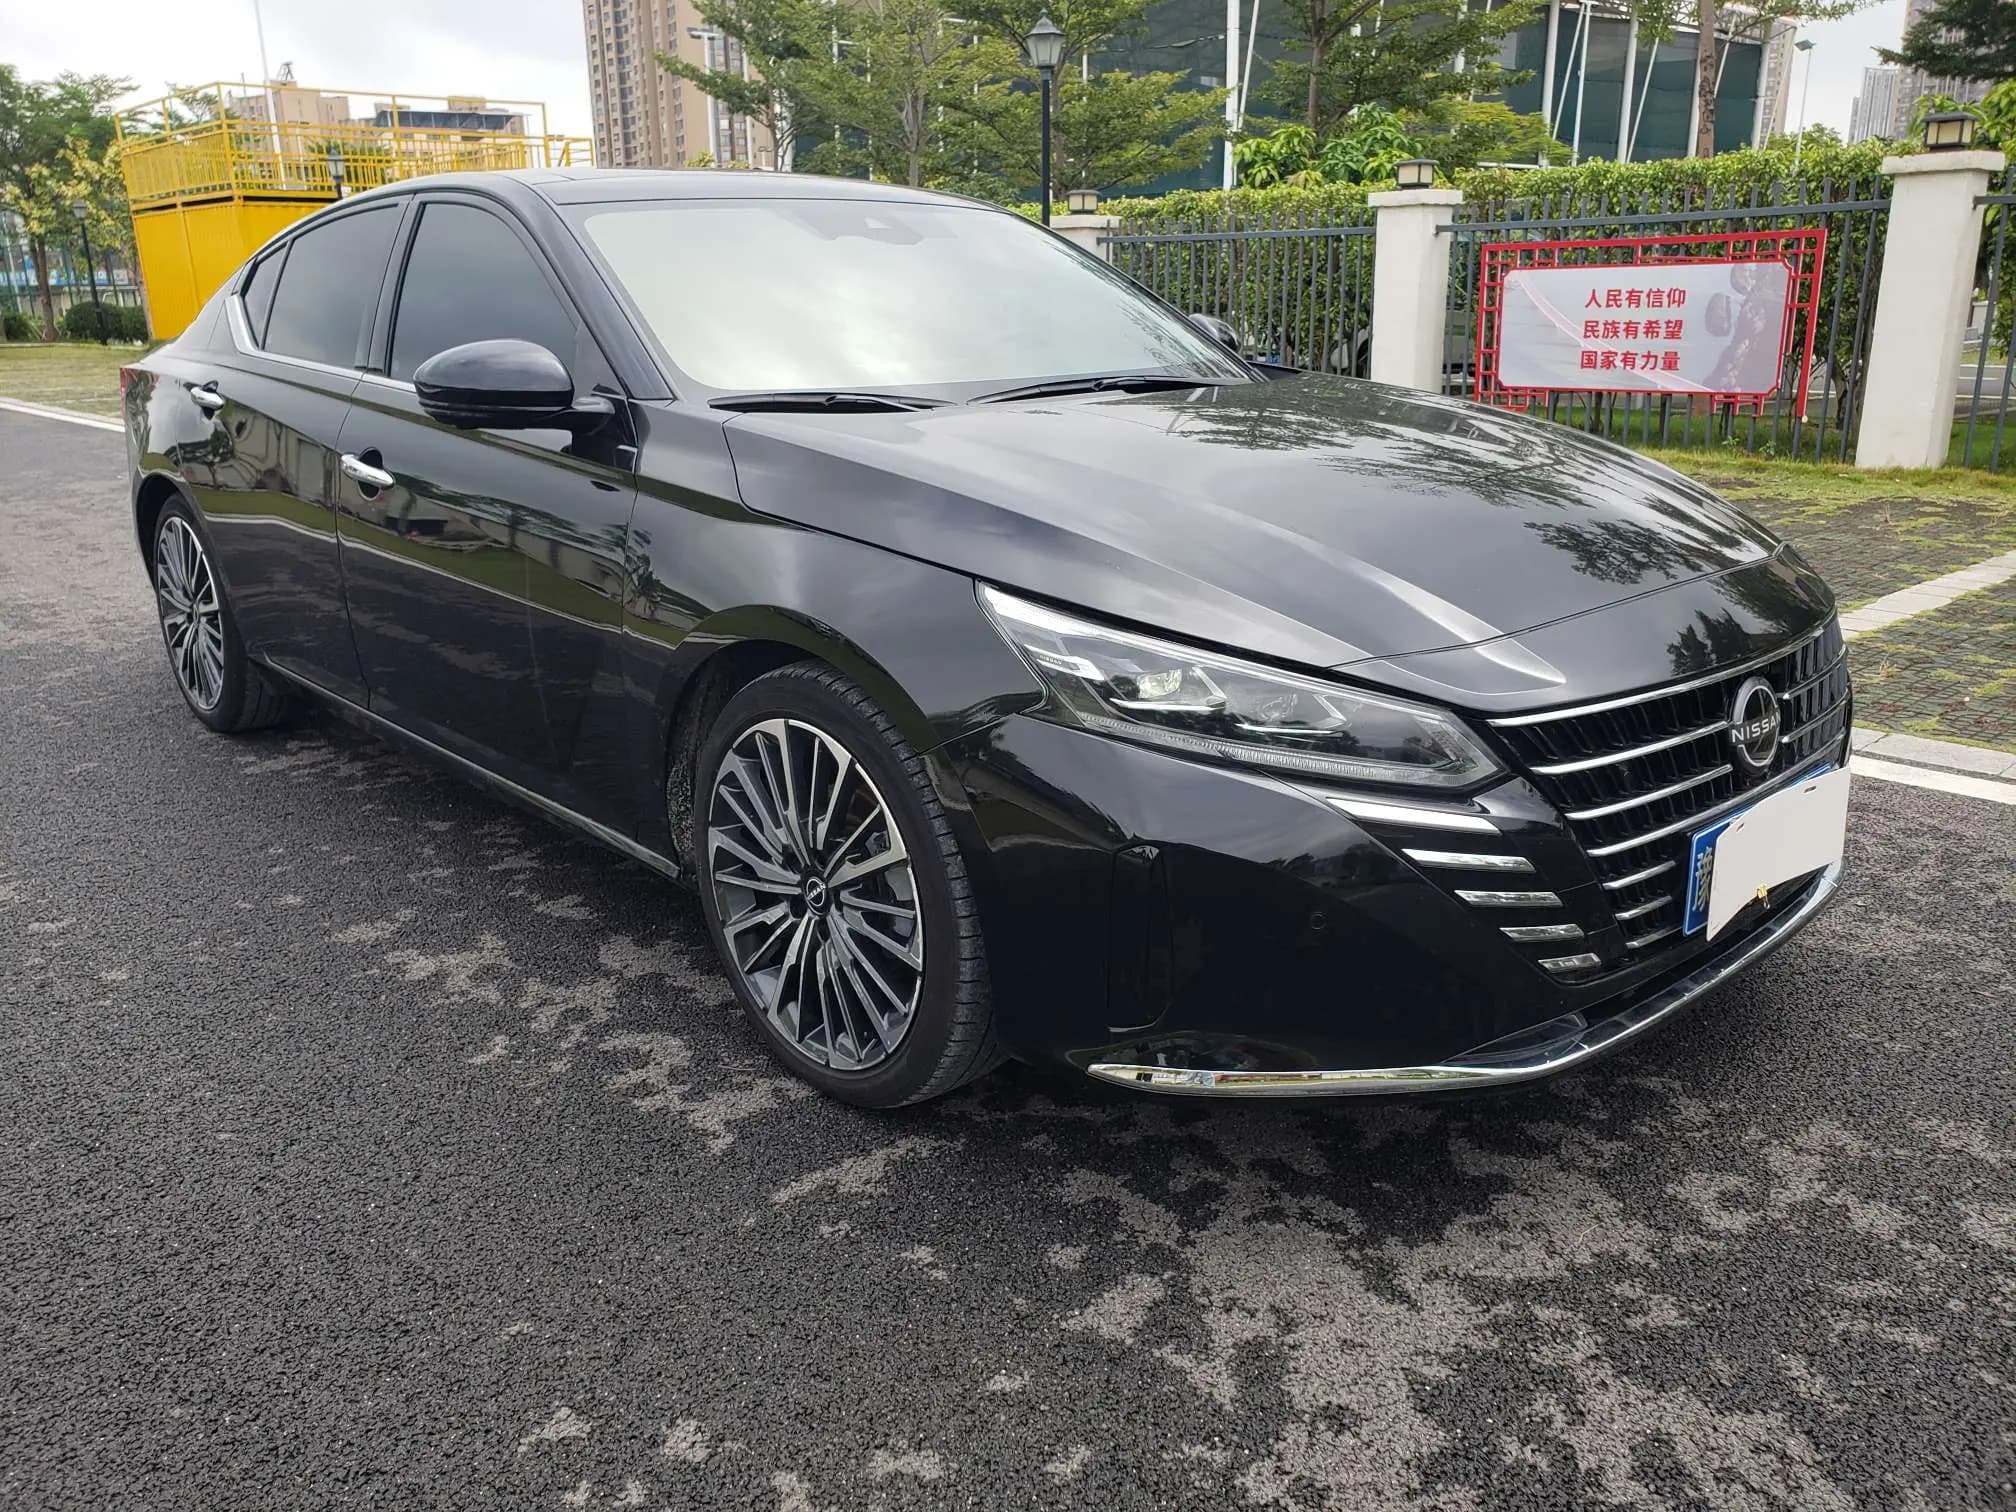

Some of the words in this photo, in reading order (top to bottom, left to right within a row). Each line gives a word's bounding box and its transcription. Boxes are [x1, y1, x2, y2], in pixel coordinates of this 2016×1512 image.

[1585, 288, 1686, 309] 人民有信仰
[1583, 320, 1684, 341] 民族有希望
[1580, 350, 1680, 372] 国家有力量
